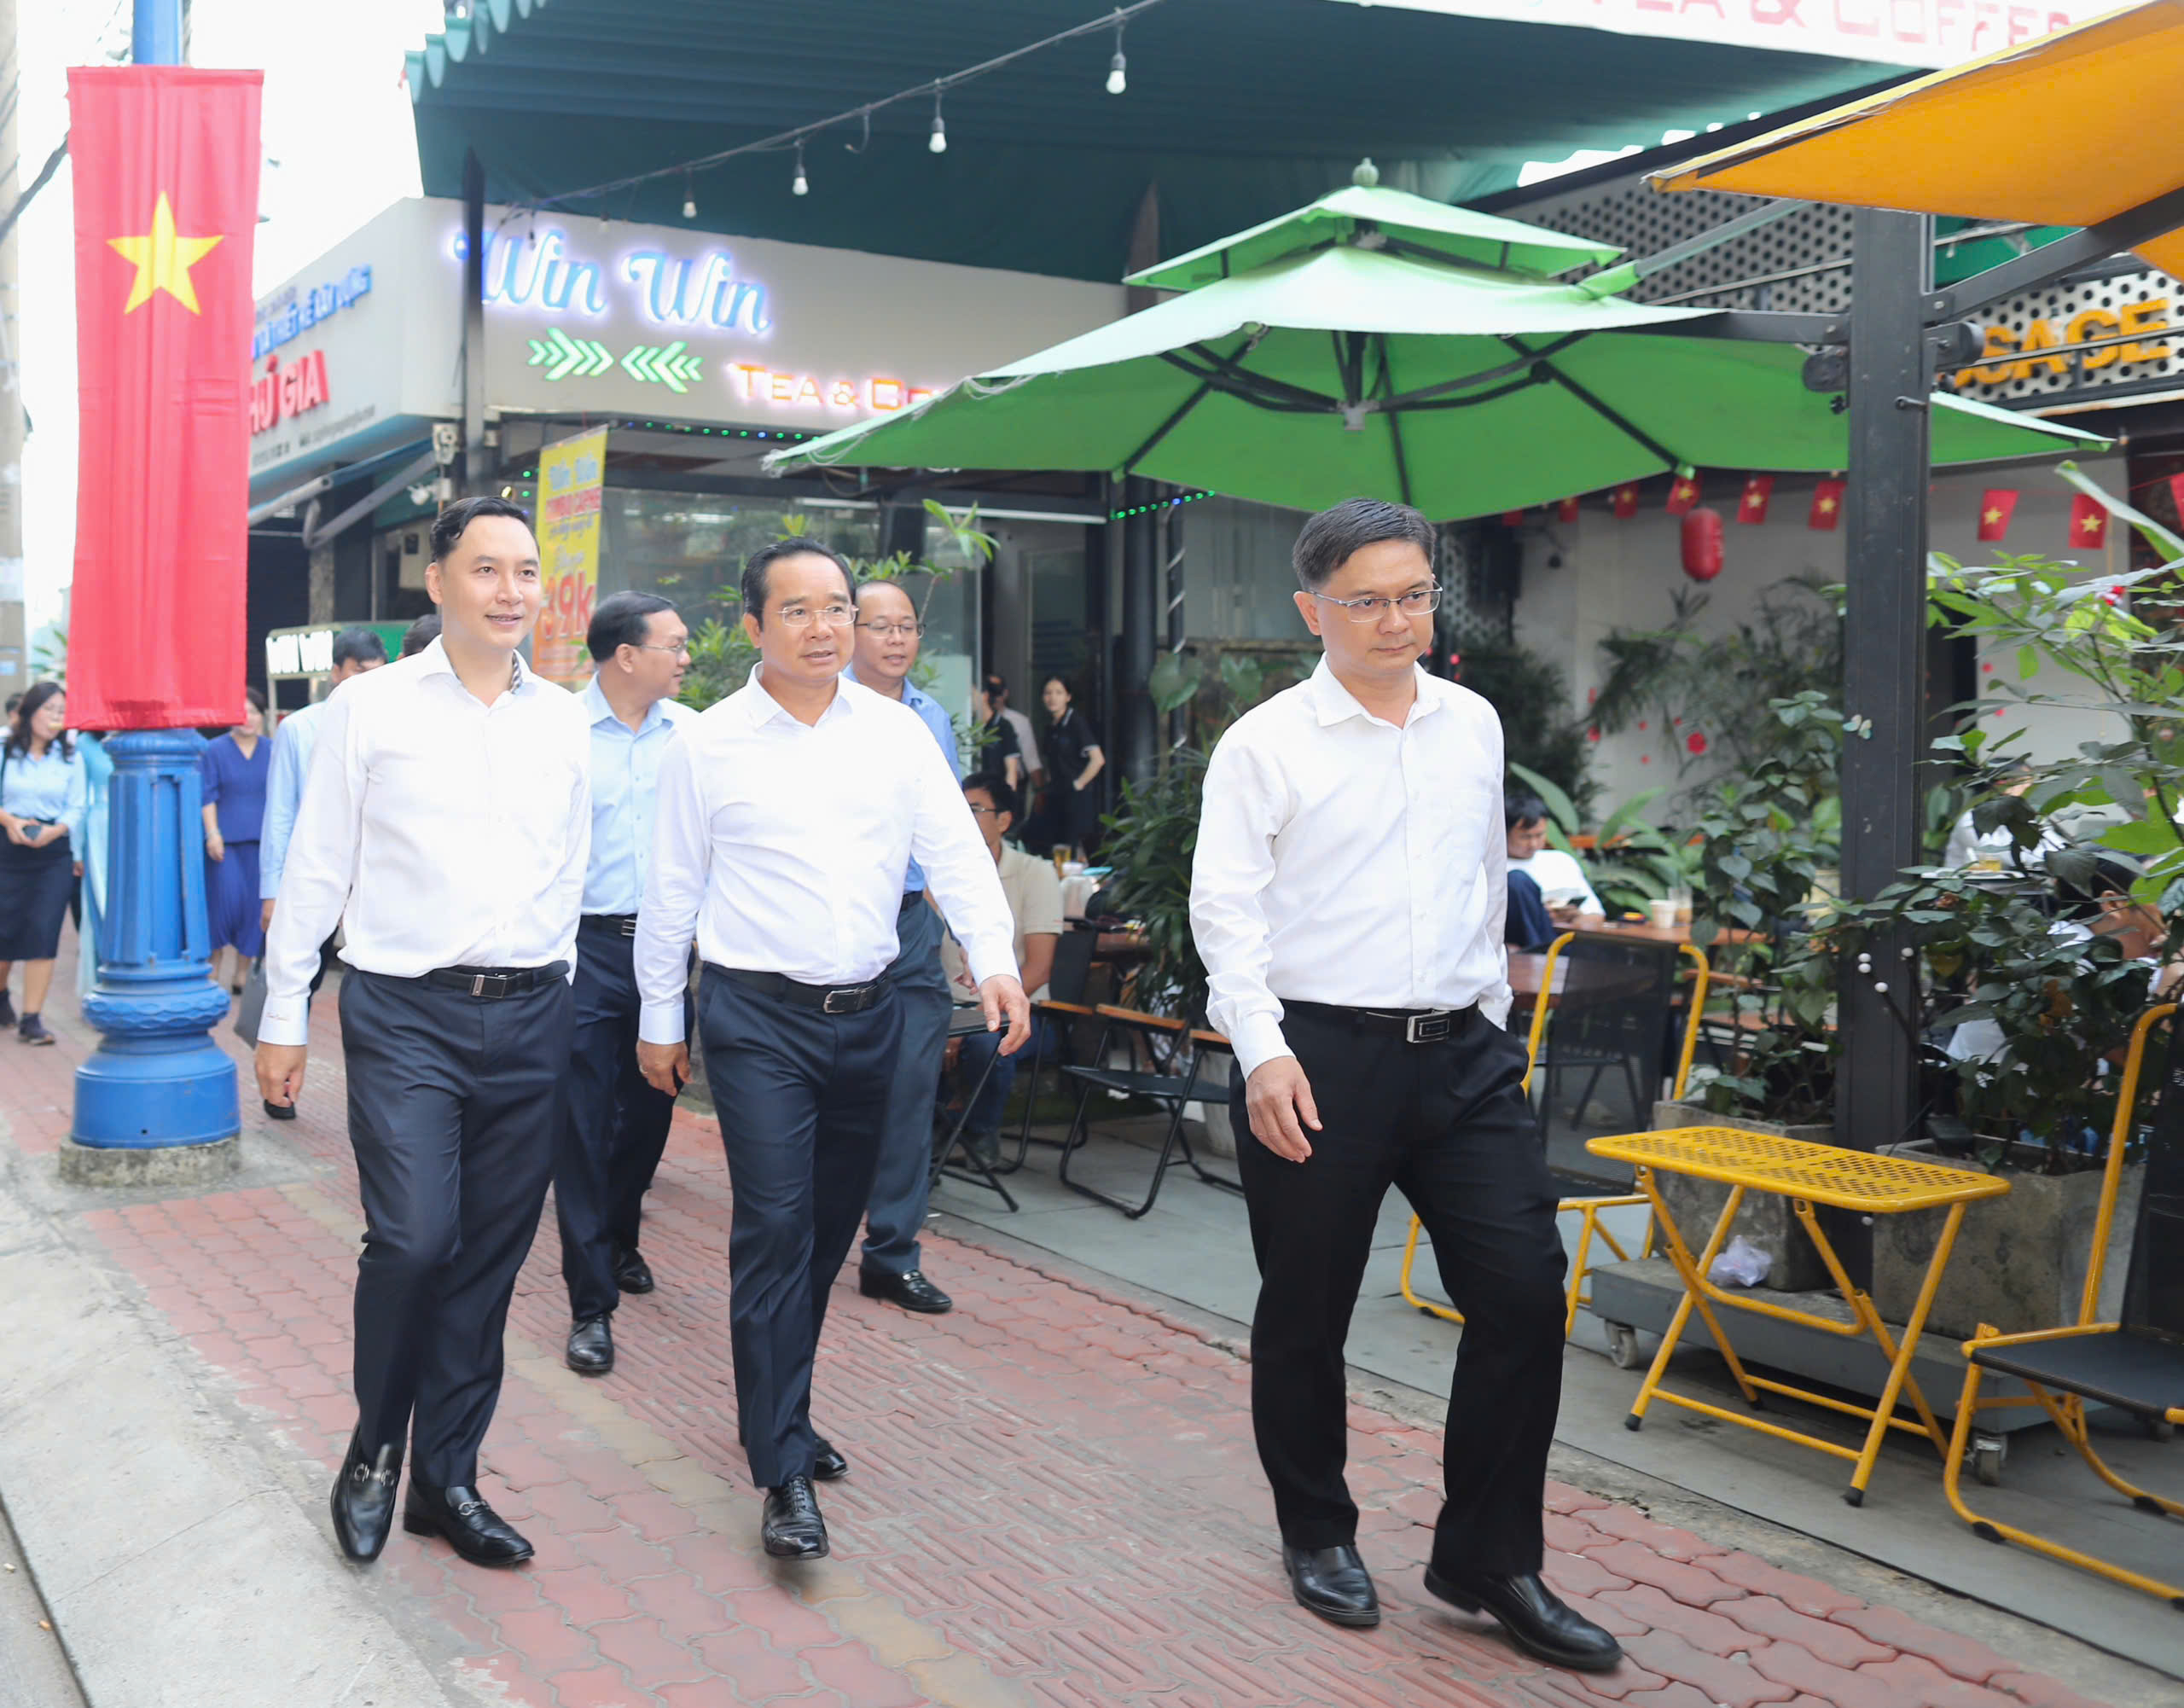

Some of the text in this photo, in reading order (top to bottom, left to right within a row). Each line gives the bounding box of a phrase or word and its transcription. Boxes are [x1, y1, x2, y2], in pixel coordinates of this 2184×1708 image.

[621, 251, 772, 335] Win
[282, 350, 330, 418] GIA
[727, 362, 824, 404] TEA
[829, 380, 860, 408] &
